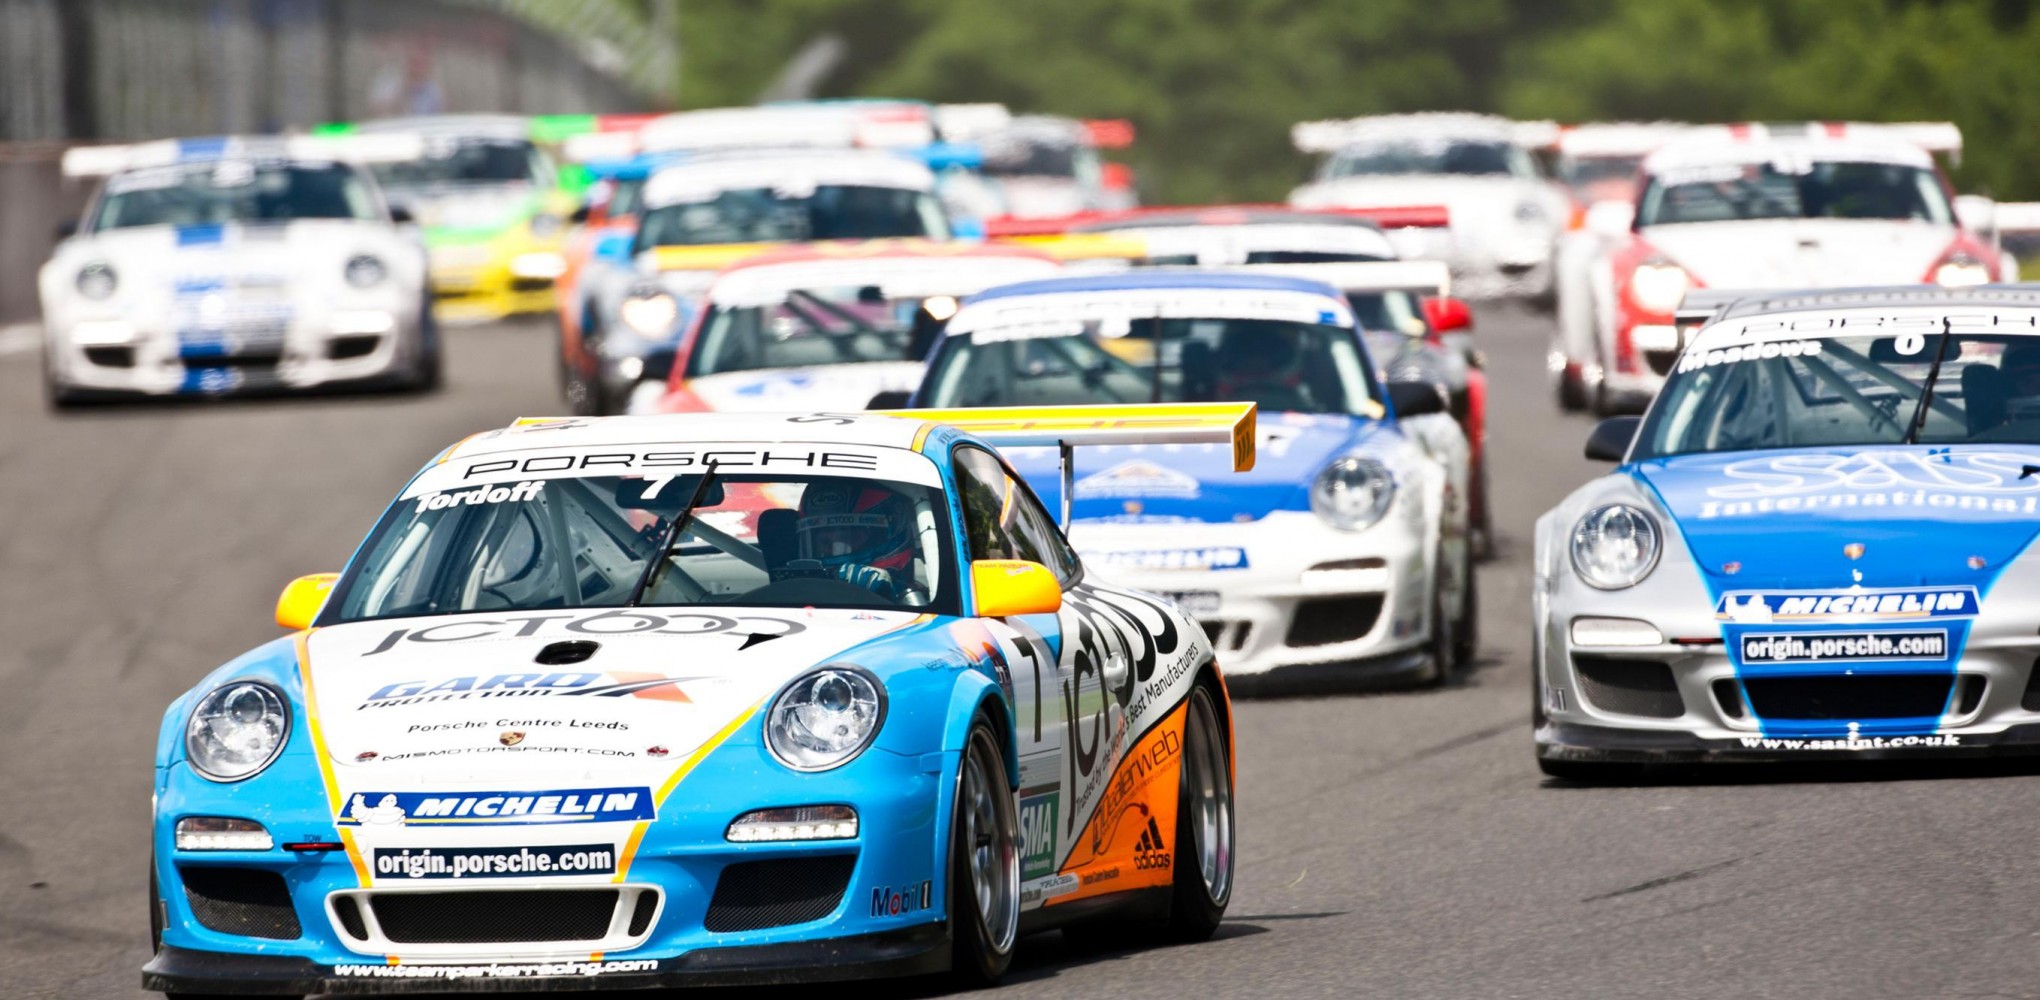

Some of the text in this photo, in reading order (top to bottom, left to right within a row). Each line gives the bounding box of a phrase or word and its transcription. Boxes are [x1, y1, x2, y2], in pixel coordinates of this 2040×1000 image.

[1676, 339, 1823, 374] Meadows
[1894, 334, 1925, 355] 0
[464, 450, 878, 479] PORSCHE
[1707, 451, 2040, 498] SAS
[414, 479, 544, 514] Tordoff
[639, 474, 678, 500] 7
[1698, 488, 2039, 519] International
[1778, 592, 1966, 615] MICHELIN
[1745, 634, 1944, 661] origin.porsche.com
[1129, 697, 1147, 724] Best
[1146, 640, 1199, 706] Manufacturers
[357, 688, 550, 711] PROTECTION
[408, 717, 630, 734] Porsche Centre Leeds
[382, 746, 636, 762] MISMOTORSPORT.COM
[1738, 733, 1962, 750] www.sasint.co.uk
[414, 792, 638, 817] MICHELIN
[1020, 802, 1052, 860] SMA
[377, 846, 613, 877] origin.porsche.com
[1134, 850, 1171, 870] adidas
[870, 880, 931, 918] Mobil 1
[334, 956, 659, 979] www.teamparkerracing.com
